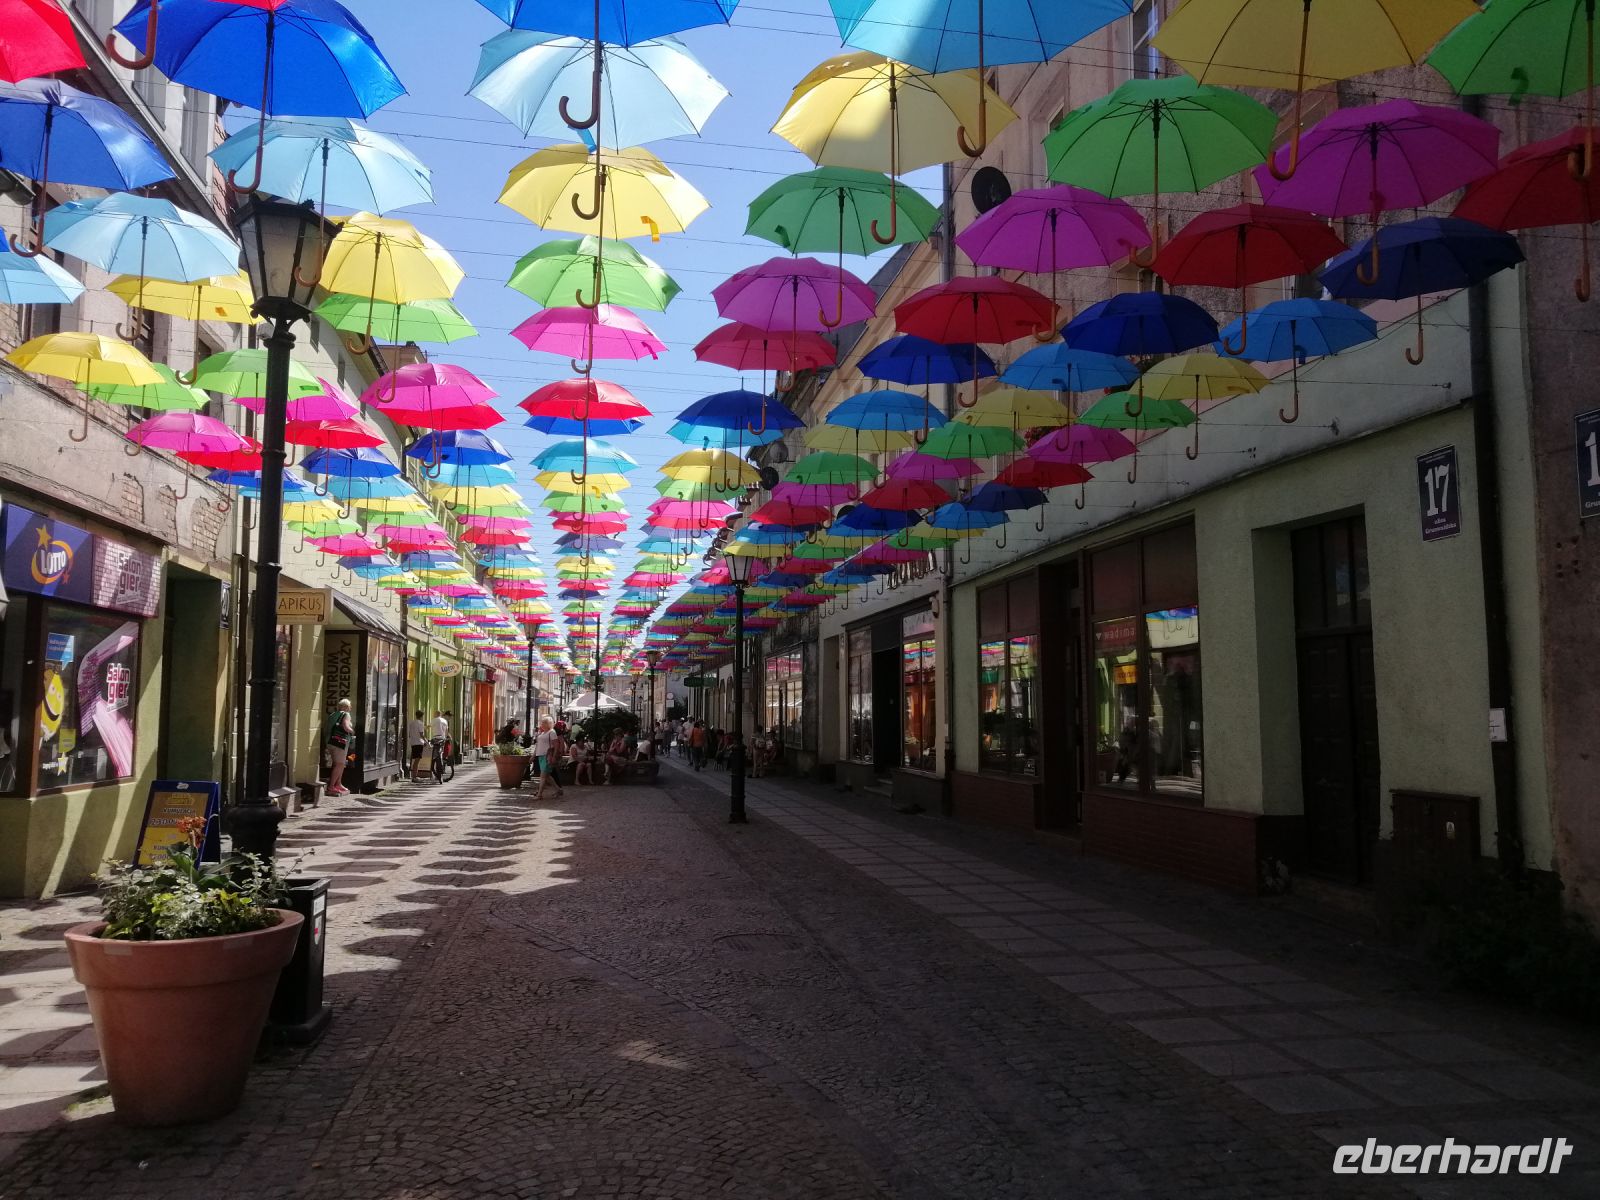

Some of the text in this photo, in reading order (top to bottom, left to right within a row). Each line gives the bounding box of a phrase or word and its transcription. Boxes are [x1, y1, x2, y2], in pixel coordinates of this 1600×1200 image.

[1424, 464, 1450, 517] 17
[41, 549, 67, 575] LOTTO
[118, 551, 142, 576] Salon
[119, 572, 140, 594] gier
[278, 597, 321, 610] APIRUS
[107, 663, 130, 683] Salon
[326, 652, 338, 714] CENTRUM
[338, 640, 352, 701] RZEDAŻY
[108, 682, 128, 704] gier
